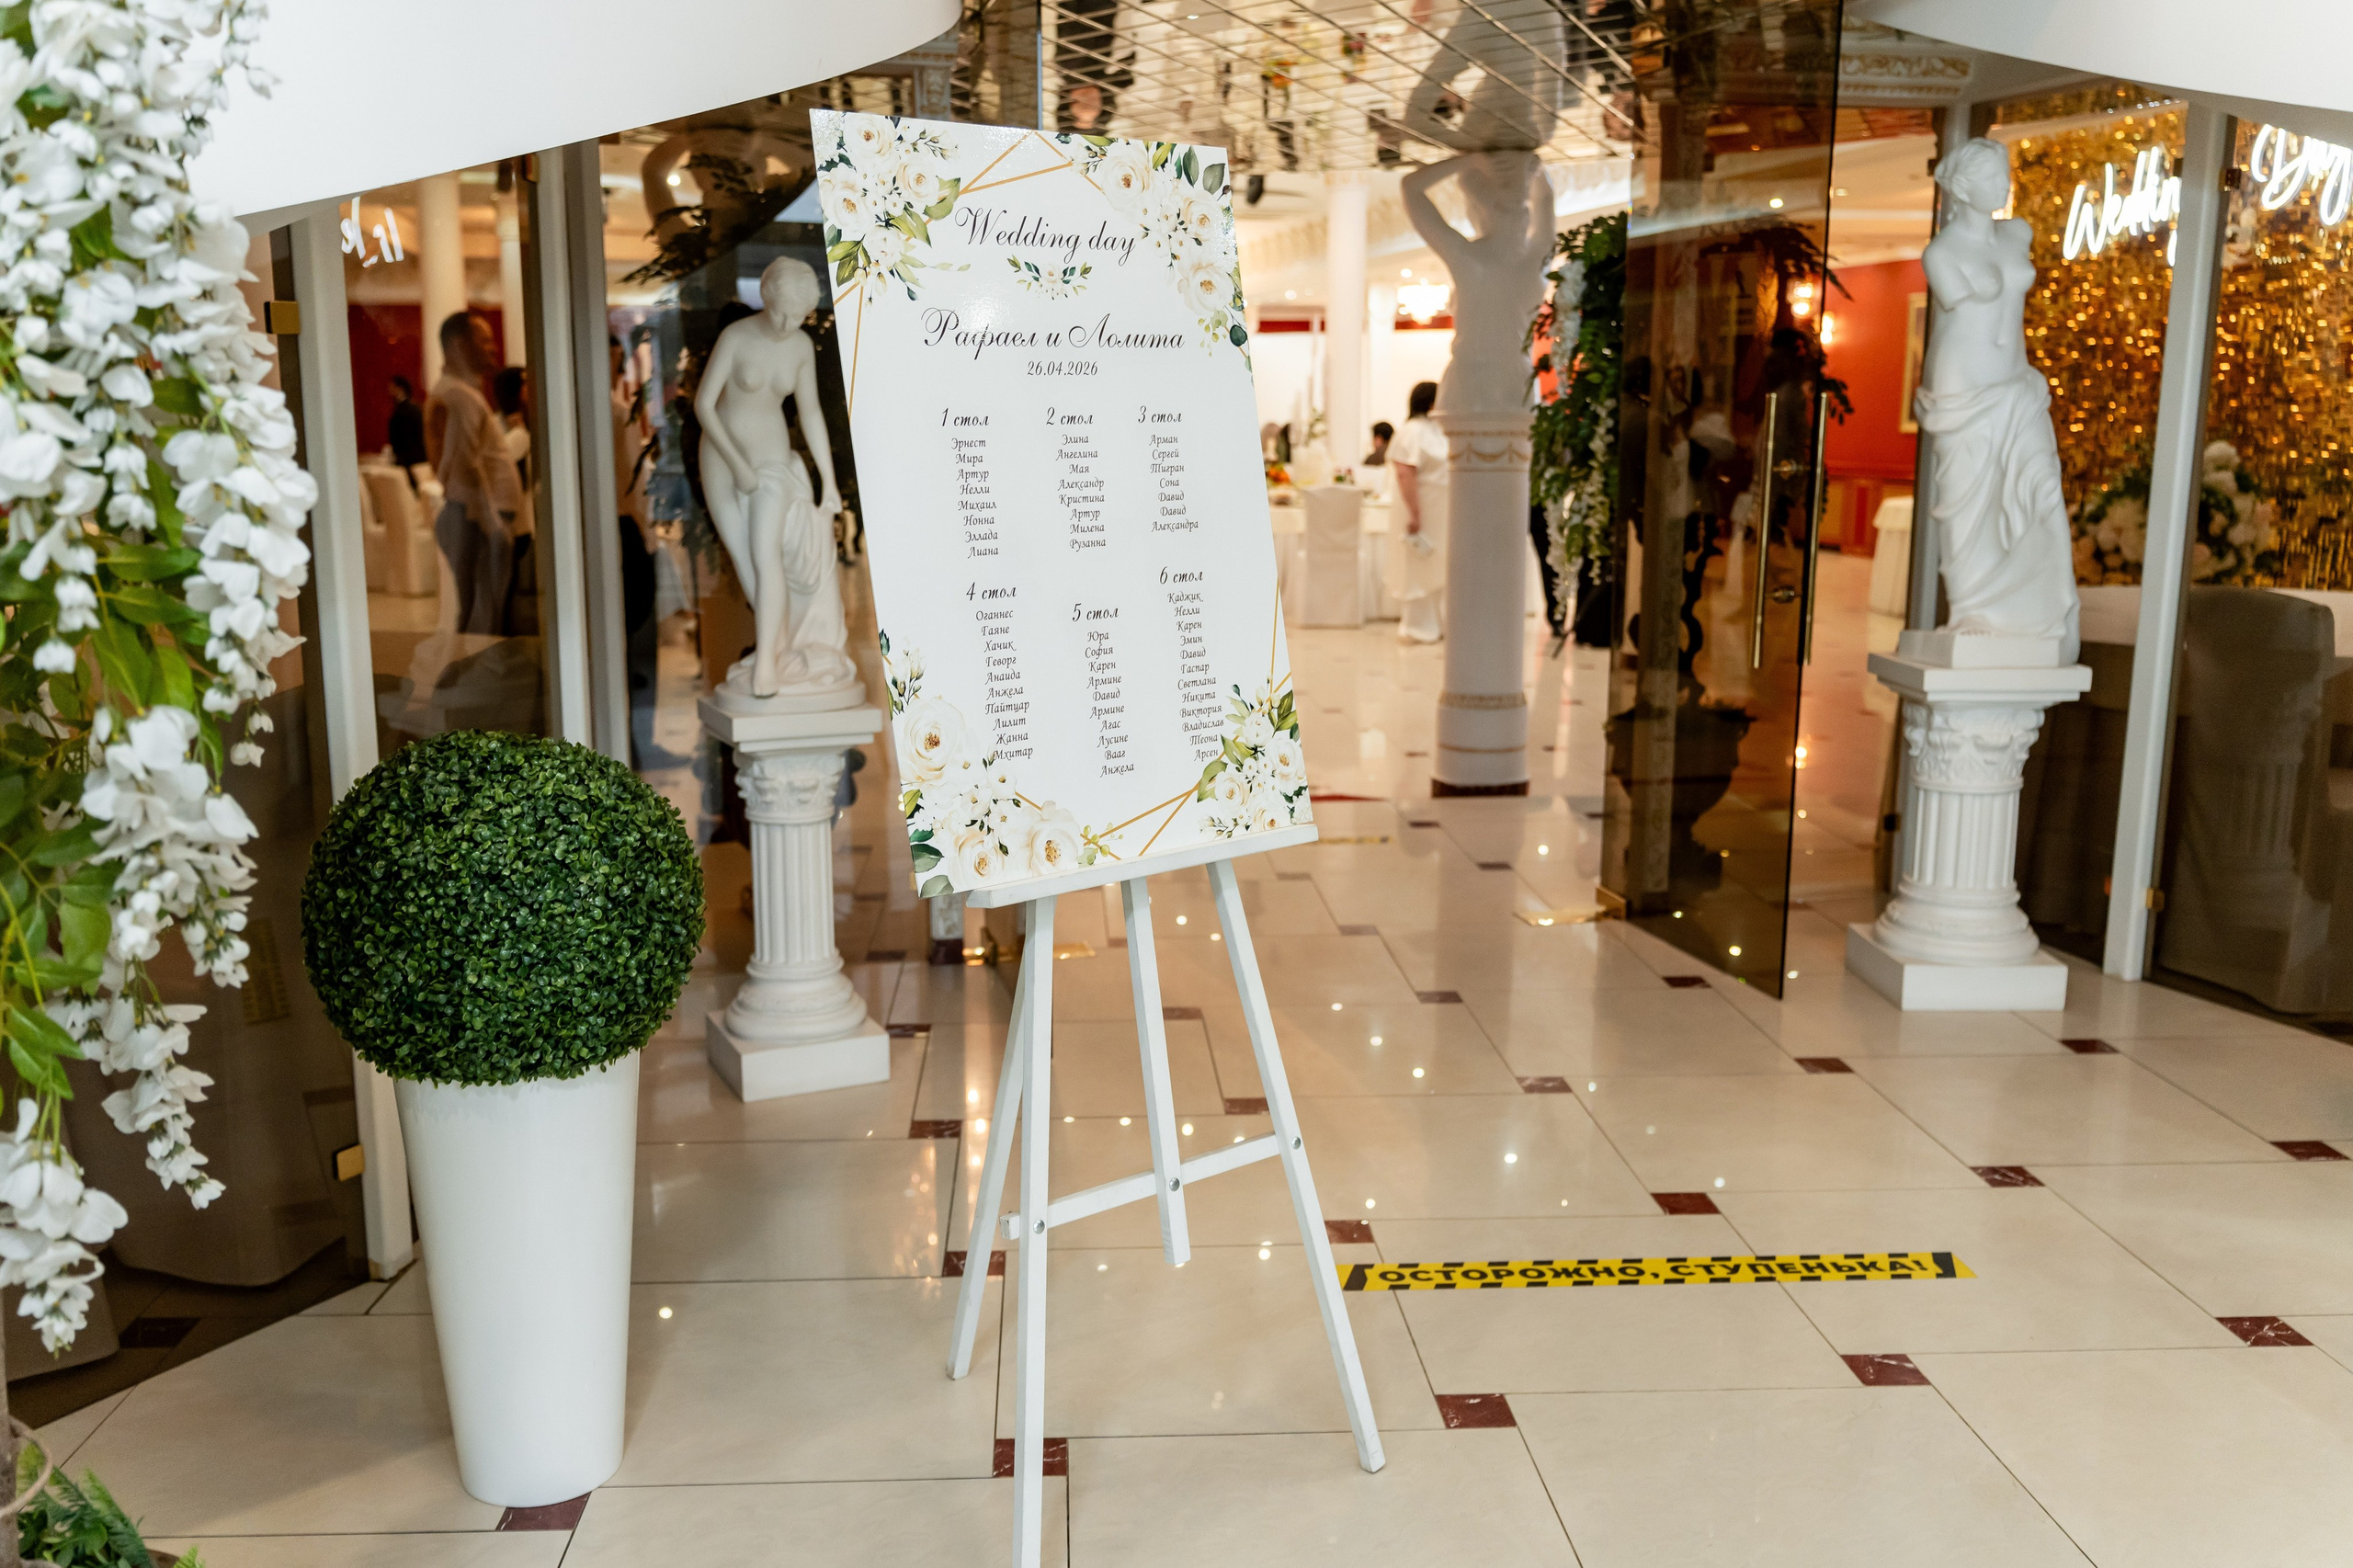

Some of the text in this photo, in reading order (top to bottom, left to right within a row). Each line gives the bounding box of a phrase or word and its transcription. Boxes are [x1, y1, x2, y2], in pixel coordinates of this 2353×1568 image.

[2063, 146, 2181, 267] Weddin
[955, 207, 1136, 267] Wedding day
[921, 308, 1185, 360] Рафаел и Лолита
[1028, 361, 1097, 376] 26.04.2026
[942, 408, 989, 426] 1 стол
[1046, 407, 1093, 425] 2 стол
[1138, 405, 1182, 424] 3 стол
[951, 437, 985, 452] Эрнест
[1062, 434, 1089, 445] Элина
[1149, 434, 1178, 448] Арман
[956, 453, 983, 467] Мира
[1055, 449, 1098, 461] Ангелина
[1153, 449, 1179, 461] Сергей
[1069, 463, 1090, 474] Мая
[1150, 462, 1184, 476] Тигран
[956, 469, 989, 483] Артур
[960, 483, 990, 494] Нелли
[1057, 477, 1104, 491] Александр
[1160, 478, 1179, 489] Сона
[1059, 494, 1105, 507] Кристина
[1158, 490, 1184, 502] Давид
[958, 500, 997, 512] Михаил
[1160, 504, 1186, 517] Давид
[963, 515, 995, 526] Нонна
[1070, 508, 1100, 522] Артур
[1070, 524, 1105, 534] Милена
[1151, 518, 1199, 532] Александра
[965, 528, 998, 543] Эллада
[1070, 539, 1107, 552] Рузанна
[967, 546, 999, 559] Лиана
[1160, 566, 1203, 585] 6 стол
[966, 582, 1017, 601] 4 стол
[1167, 591, 1203, 604] Каджик
[976, 610, 1013, 621] Оганнес
[1073, 603, 1119, 622] 5 стол
[1175, 606, 1200, 617] Нелли
[982, 626, 1009, 636] Гаяне
[1176, 620, 1202, 633] Карен
[1086, 631, 1110, 646] Юра
[1180, 635, 1202, 646] Эмин
[983, 640, 1017, 653] Хачик
[1085, 641, 1113, 660] София
[1180, 646, 1206, 660] Давид
[985, 656, 1017, 669] Геворг
[1088, 661, 1116, 674] Карен
[1180, 664, 1210, 675] Гаспар
[985, 668, 1020, 685] Анаида
[1086, 676, 1121, 689] Армине
[1177, 677, 1216, 690] Светлана
[986, 687, 1024, 700] Анжела
[1092, 687, 1120, 701] Давид
[1182, 691, 1215, 703] Никита
[985, 702, 1029, 715] Пайтцар
[1089, 706, 1124, 720] Армине
[1179, 705, 1222, 718] Виктория
[993, 718, 1026, 731] Лилит
[1100, 720, 1121, 733] Агас
[1182, 719, 1224, 732] Владислав
[995, 733, 1029, 745] Жанна
[1097, 735, 1128, 749] Лусине
[1189, 733, 1218, 746] Теона
[992, 747, 1033, 761] Мхитар
[1105, 750, 1125, 760] Вааг
[1194, 749, 1219, 762] Арсен
[1099, 764, 1134, 778] Анжела
[1378, 1260, 1928, 1282] ОСТОРОЖНО, СТУПЕНЬКА!
